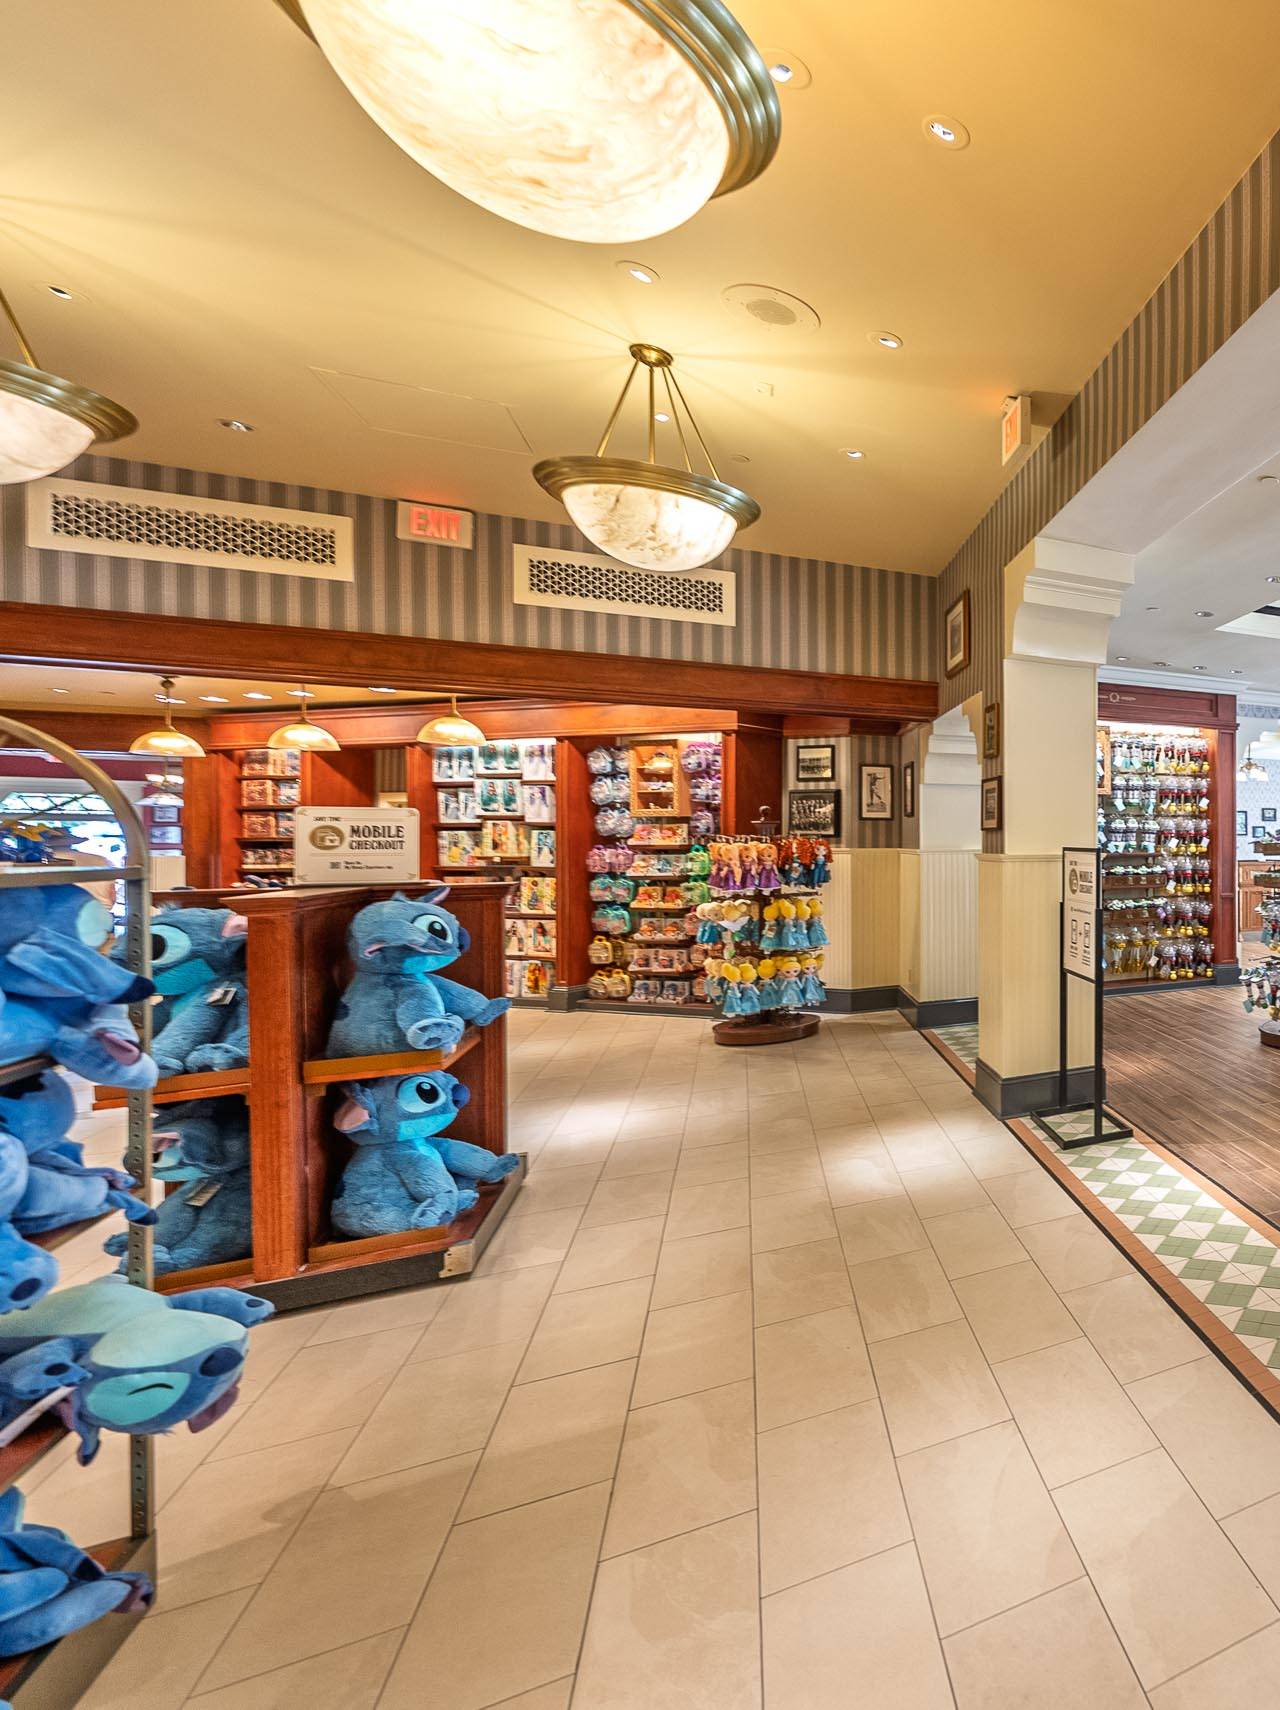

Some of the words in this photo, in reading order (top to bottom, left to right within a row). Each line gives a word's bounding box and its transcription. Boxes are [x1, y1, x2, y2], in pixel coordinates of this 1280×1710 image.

[411, 505, 461, 540] EXIT
[349, 825, 405, 839] MOBILE
[349, 840, 406, 850] CHECKOUT
